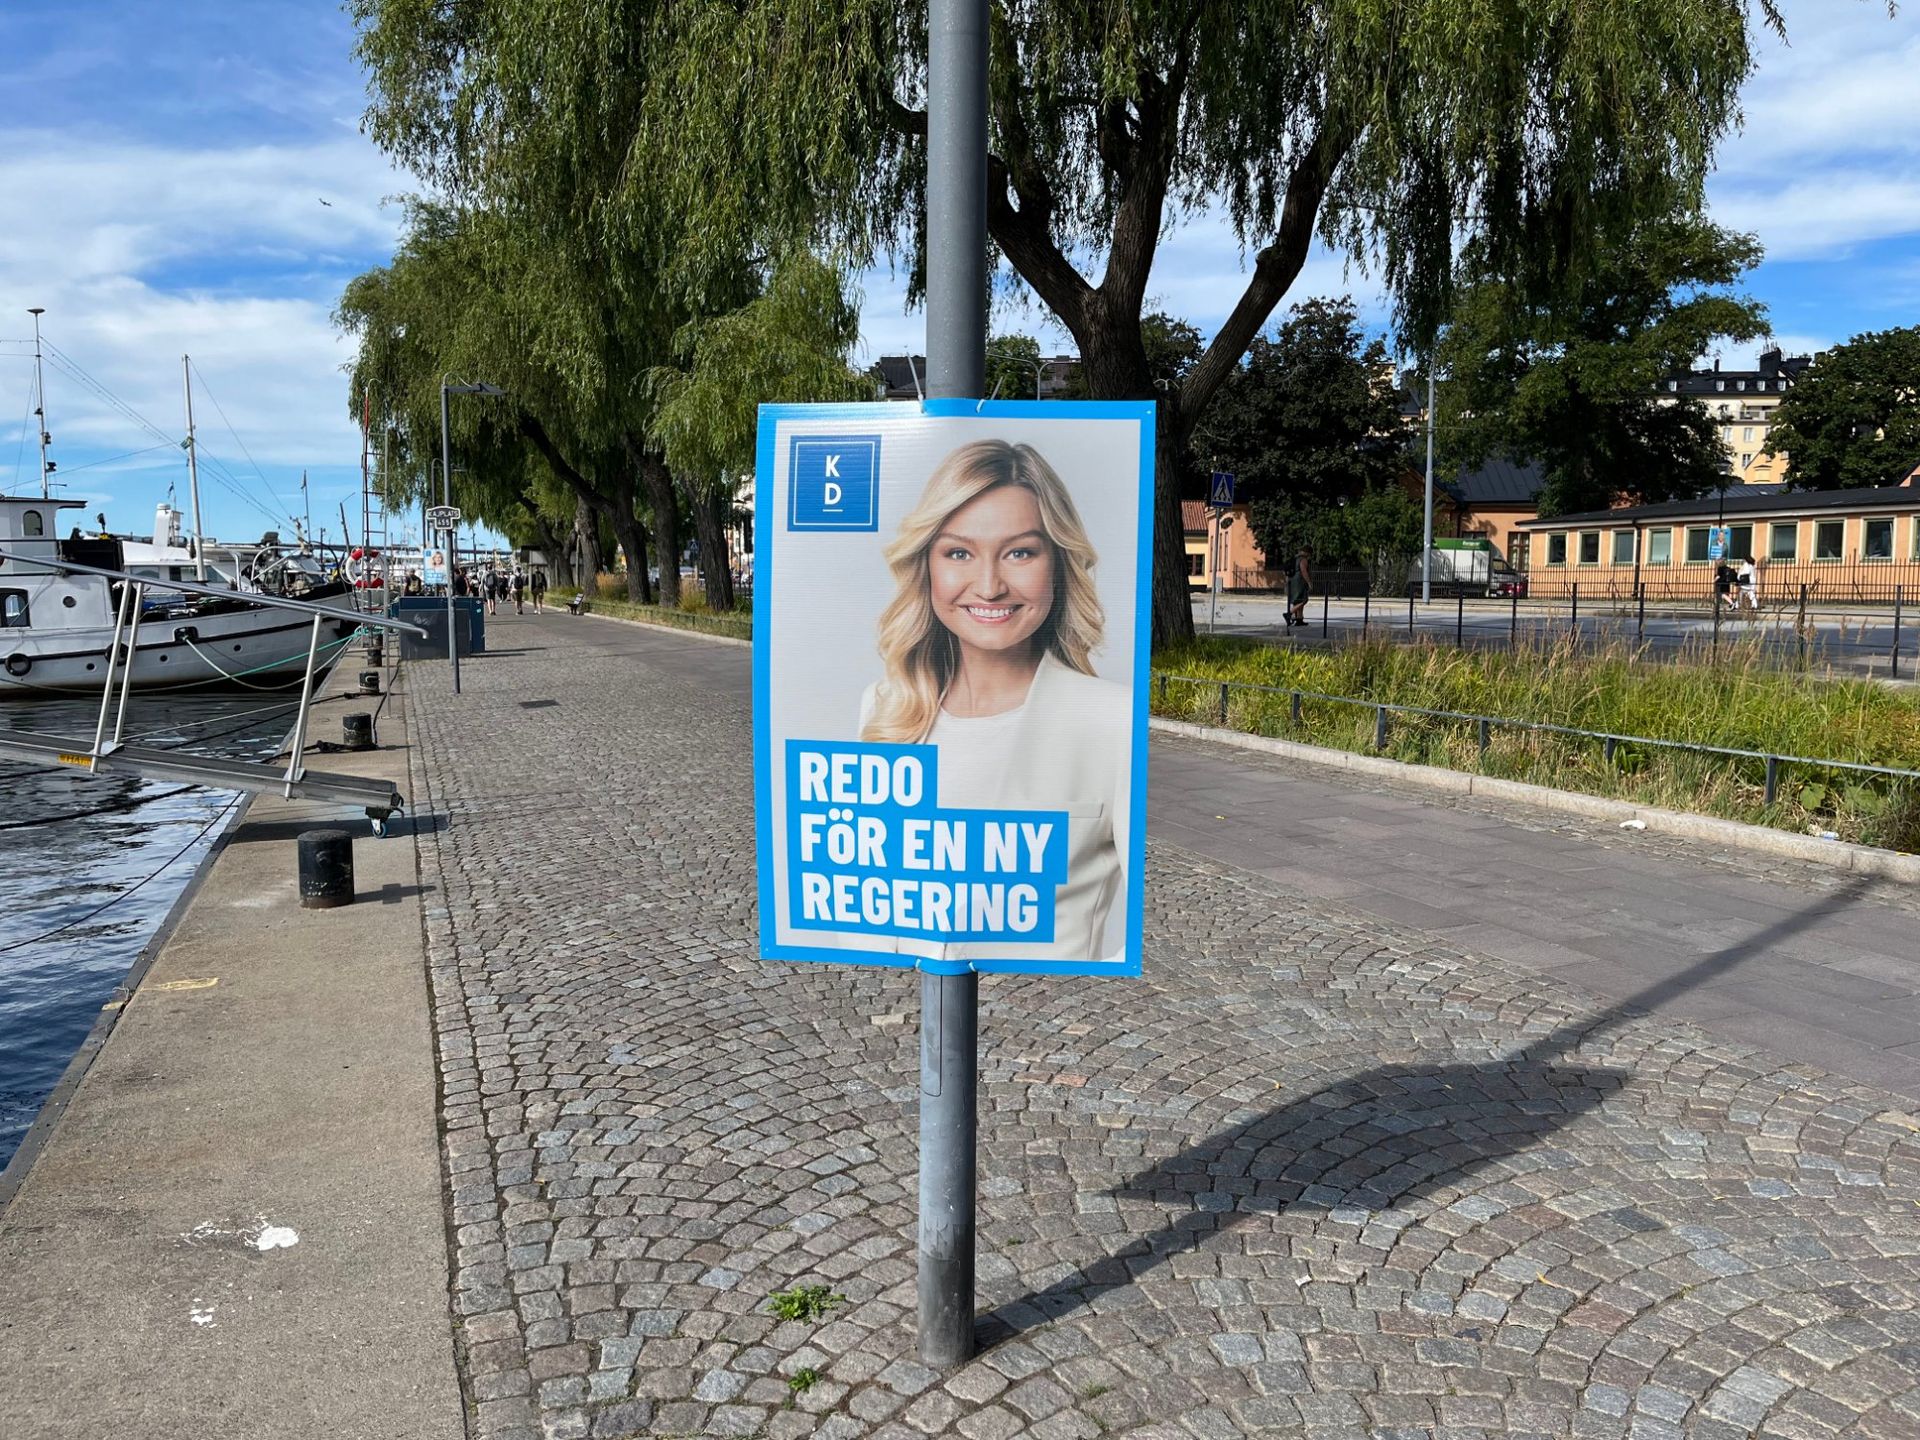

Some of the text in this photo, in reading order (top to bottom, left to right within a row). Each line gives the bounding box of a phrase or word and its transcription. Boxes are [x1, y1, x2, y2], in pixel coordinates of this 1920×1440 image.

[428, 510, 459, 518] KAJPLATS
[799, 751, 923, 807] REDO
[800, 808, 1054, 874] FÖR EN NY
[802, 871, 1039, 933] REGERING
